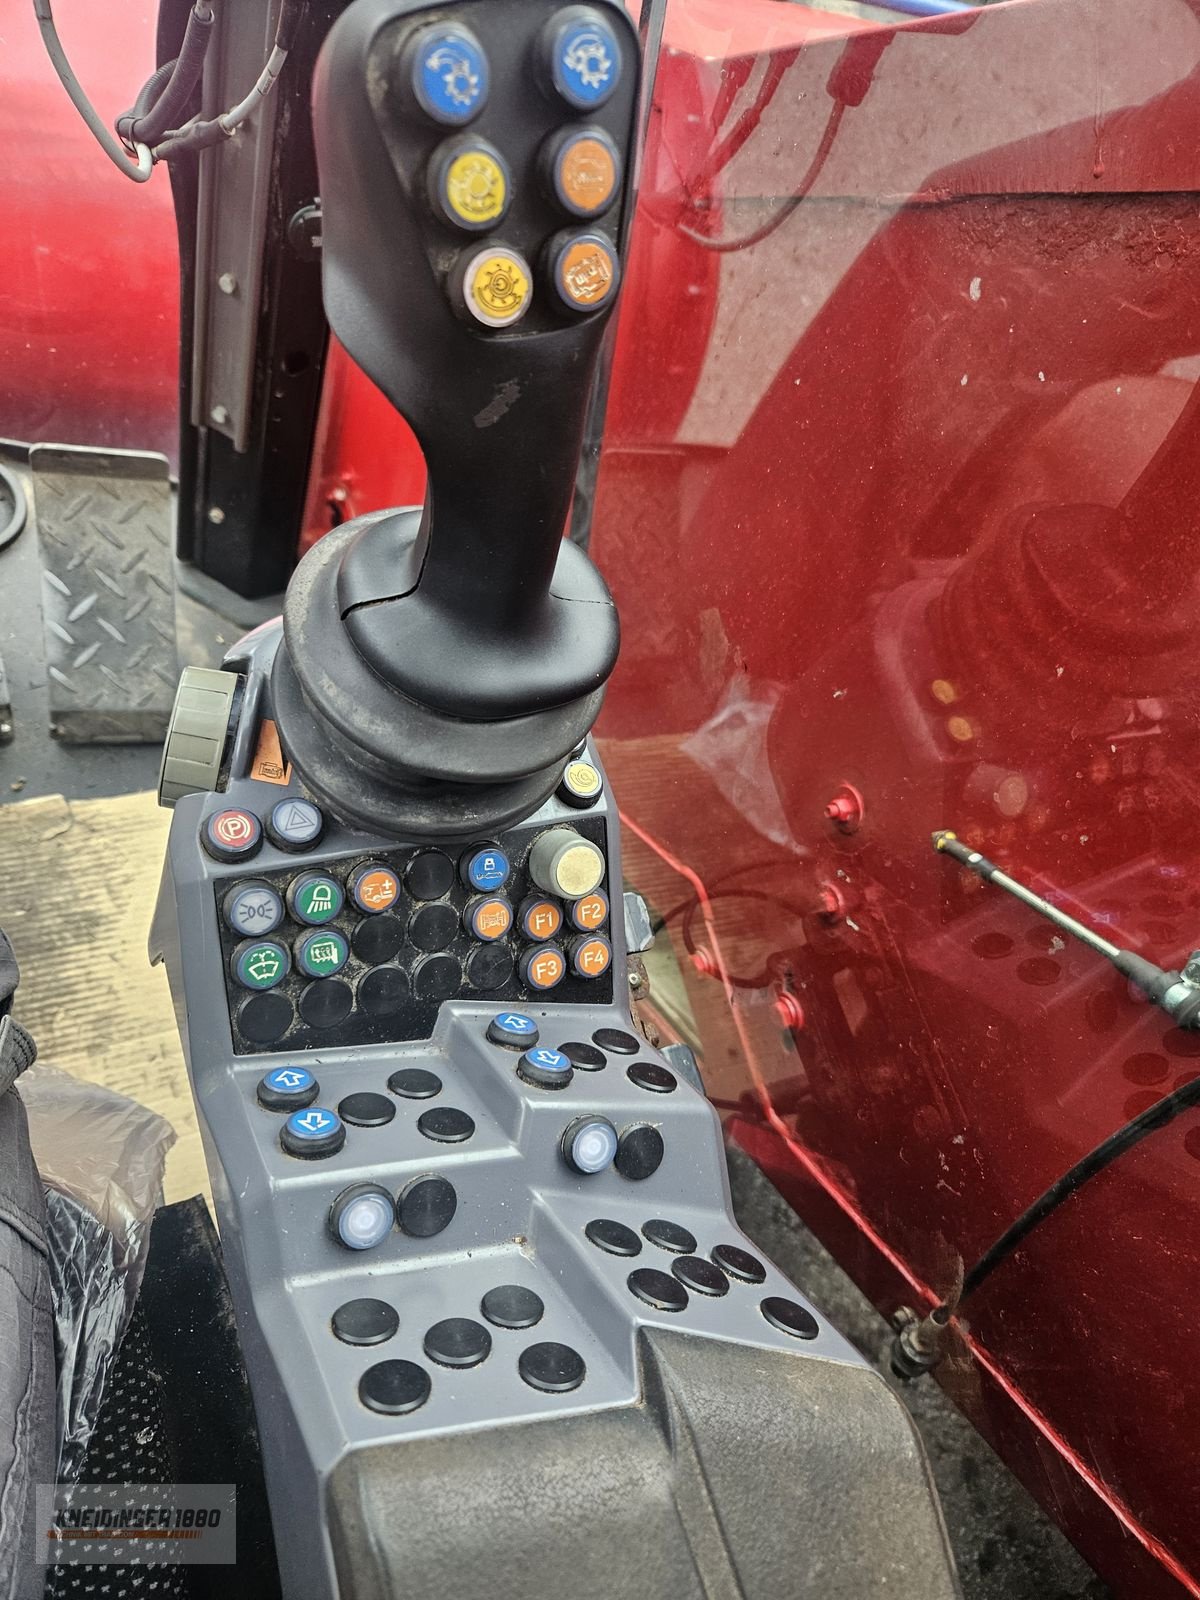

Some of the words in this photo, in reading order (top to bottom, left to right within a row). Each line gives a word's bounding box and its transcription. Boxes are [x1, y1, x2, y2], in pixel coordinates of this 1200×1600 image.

[535, 911, 553, 930] F1
[581, 903, 601, 921] F2
[583, 949, 604, 968] F4
[536, 960, 557, 980] F3
